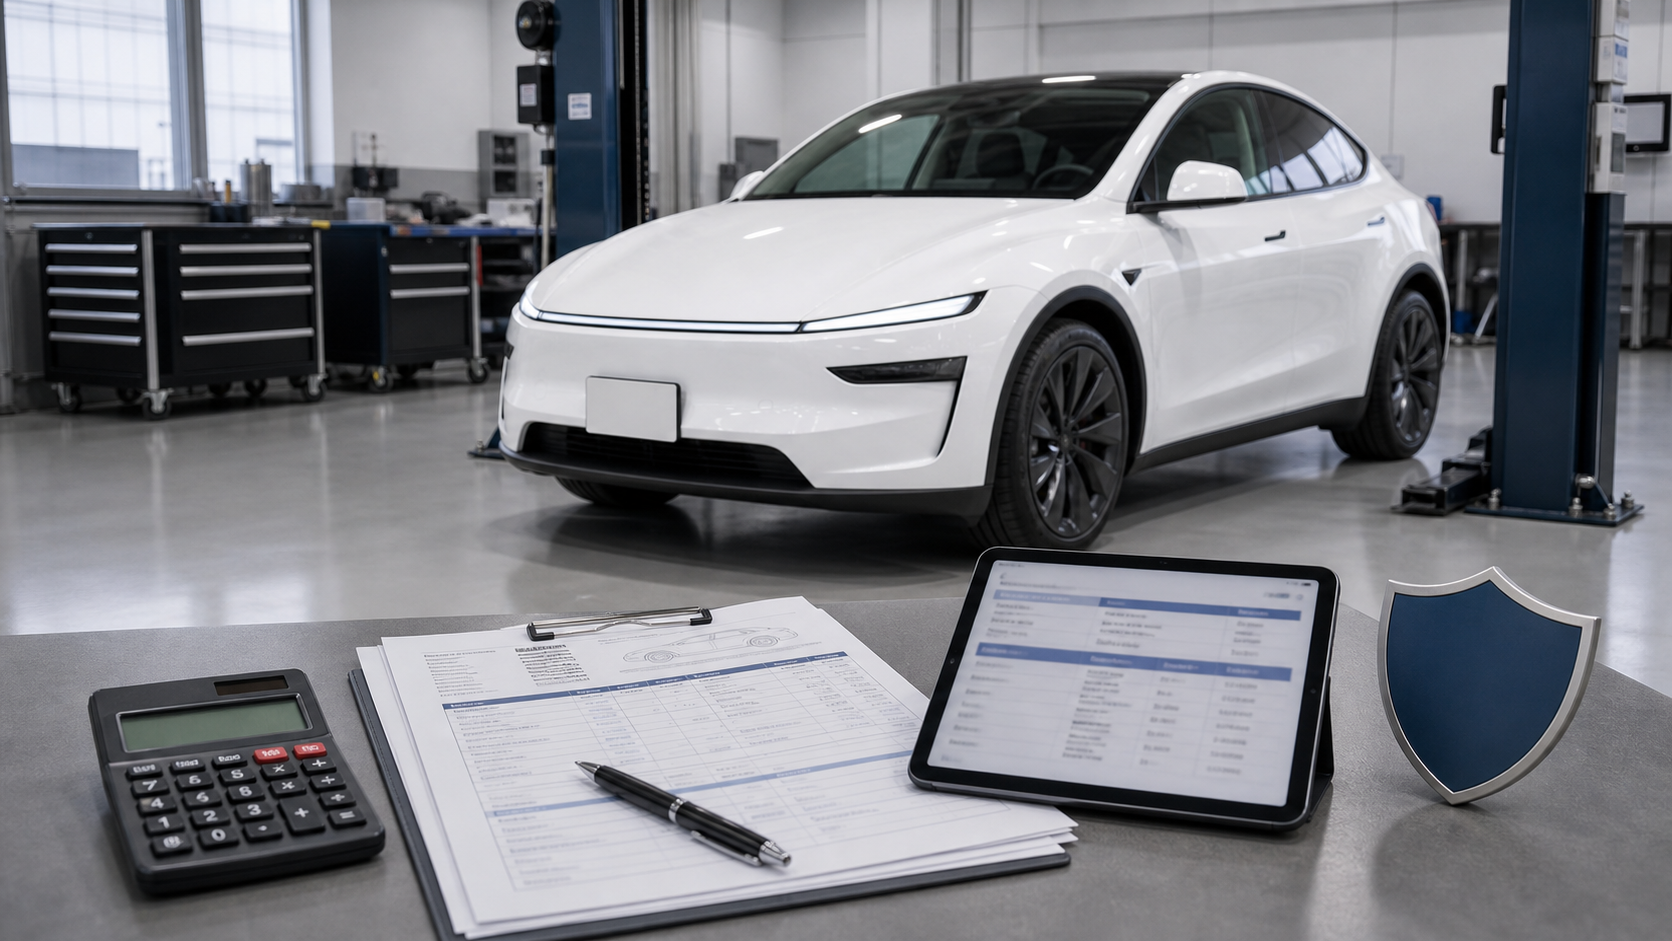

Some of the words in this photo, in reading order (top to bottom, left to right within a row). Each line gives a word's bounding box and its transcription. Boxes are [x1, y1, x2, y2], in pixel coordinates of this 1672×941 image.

[142, 779, 158, 791] 7
[150, 797, 165, 809] 4
[158, 816, 171, 829] 1
[203, 810, 218, 822] 2
[247, 803, 262, 816] 3
[211, 828, 226, 842] 0
